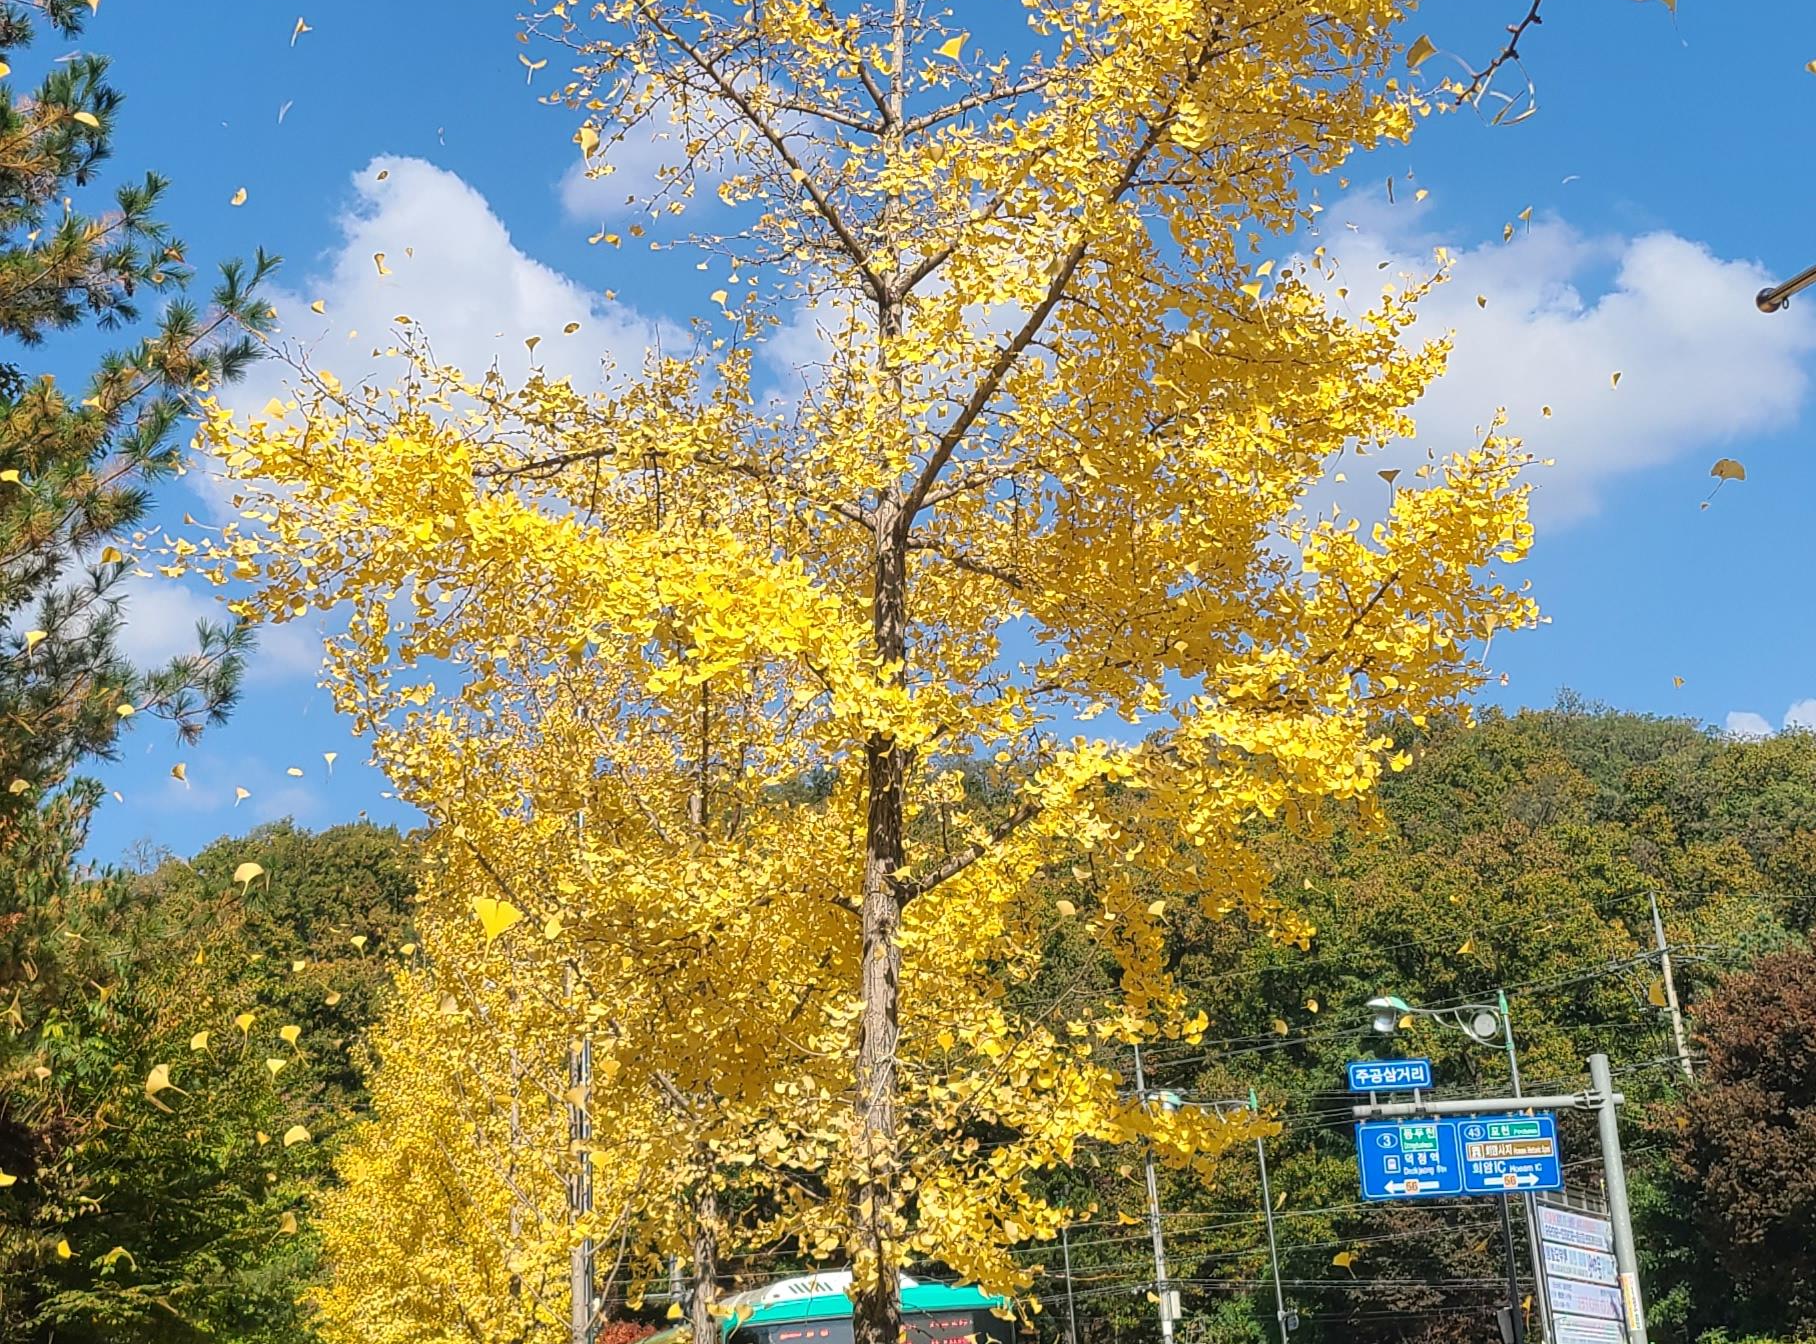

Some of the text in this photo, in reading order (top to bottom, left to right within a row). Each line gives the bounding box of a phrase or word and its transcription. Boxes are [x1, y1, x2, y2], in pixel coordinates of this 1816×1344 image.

[1355, 1065, 1425, 1085] 주공삼거리
[1468, 1127, 1482, 1138] 43
[1383, 1135, 1392, 1148] 3
[1471, 1160, 1507, 1175] 회암IC
[1503, 1175, 1517, 1186] 56
